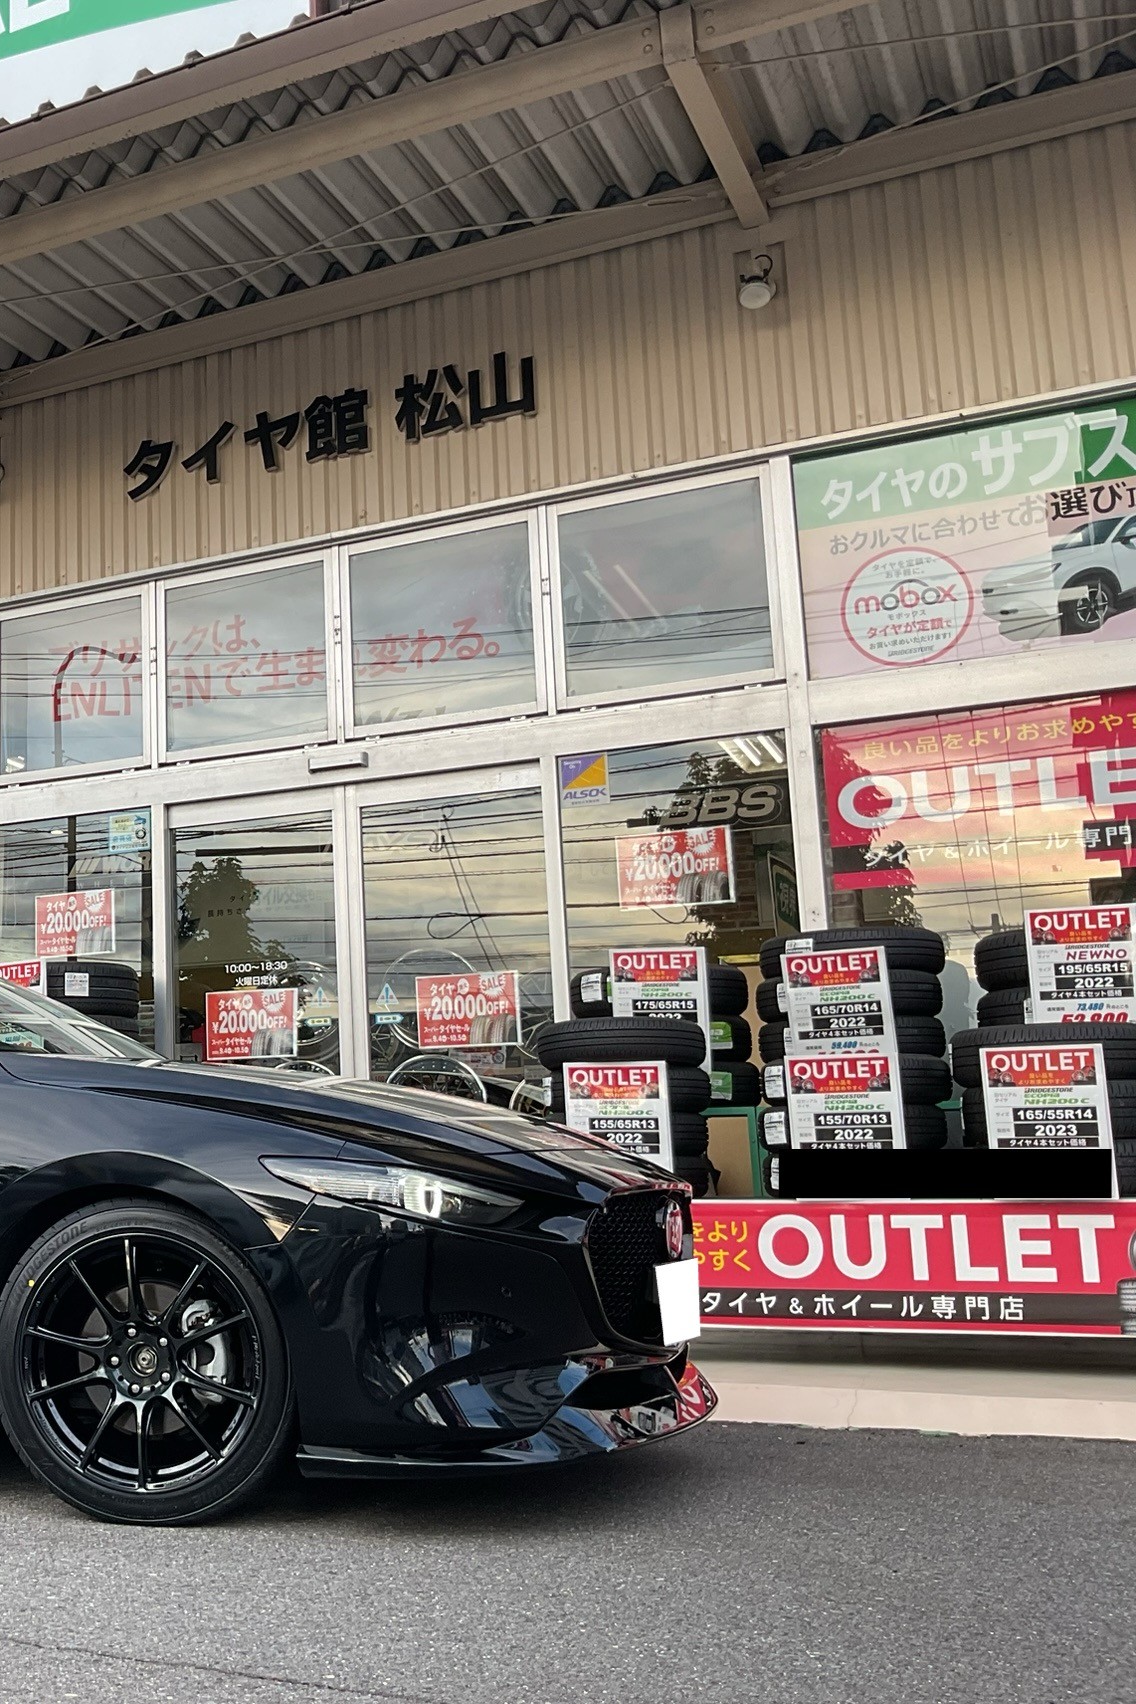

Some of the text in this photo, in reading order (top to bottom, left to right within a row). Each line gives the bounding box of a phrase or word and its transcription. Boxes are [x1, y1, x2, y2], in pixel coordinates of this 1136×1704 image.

[123, 351, 537, 502] タイヤ館 松山
[854, 583, 959, 614] mobox
[563, 788, 607, 800] ALSOK
[660, 784, 778, 825] BBS
[688, 829, 716, 848] SALE
[1034, 910, 1126, 931] OUTLET
[1066, 949, 1127, 961] NEWNO
[617, 953, 693, 970] OUTLET
[791, 953, 874, 974] OUTLET
[1058, 962, 1128, 974] 195/65R15
[235, 975, 279, 987] 火曜日定休
[481, 974, 506, 991] SALE
[1074, 977, 1114, 989] 2022
[430, 982, 456, 996] タイヤ
[264, 991, 285, 1006] SALE
[635, 1000, 694, 1009] 175/65R15
[814, 1003, 879, 1015] 165/70R14
[829, 1016, 866, 1028] 2022
[991, 1051, 1090, 1072] OUTLET
[793, 1059, 885, 1079] OUTLET
[572, 1069, 655, 1086] OUTLET
[818, 1114, 887, 1125] 155/70R13
[1017, 1108, 1093, 1120] 165/55R14
[592, 1119, 655, 1129] 155/65R13
[1034, 1124, 1078, 1136] 2023
[606, 1133, 643, 1144] 2022
[834, 1129, 874, 1140] 2022
[1009, 1138, 1087, 1147] タイヤ4本セット価格
[757, 1213, 1116, 1284] OUTLET
